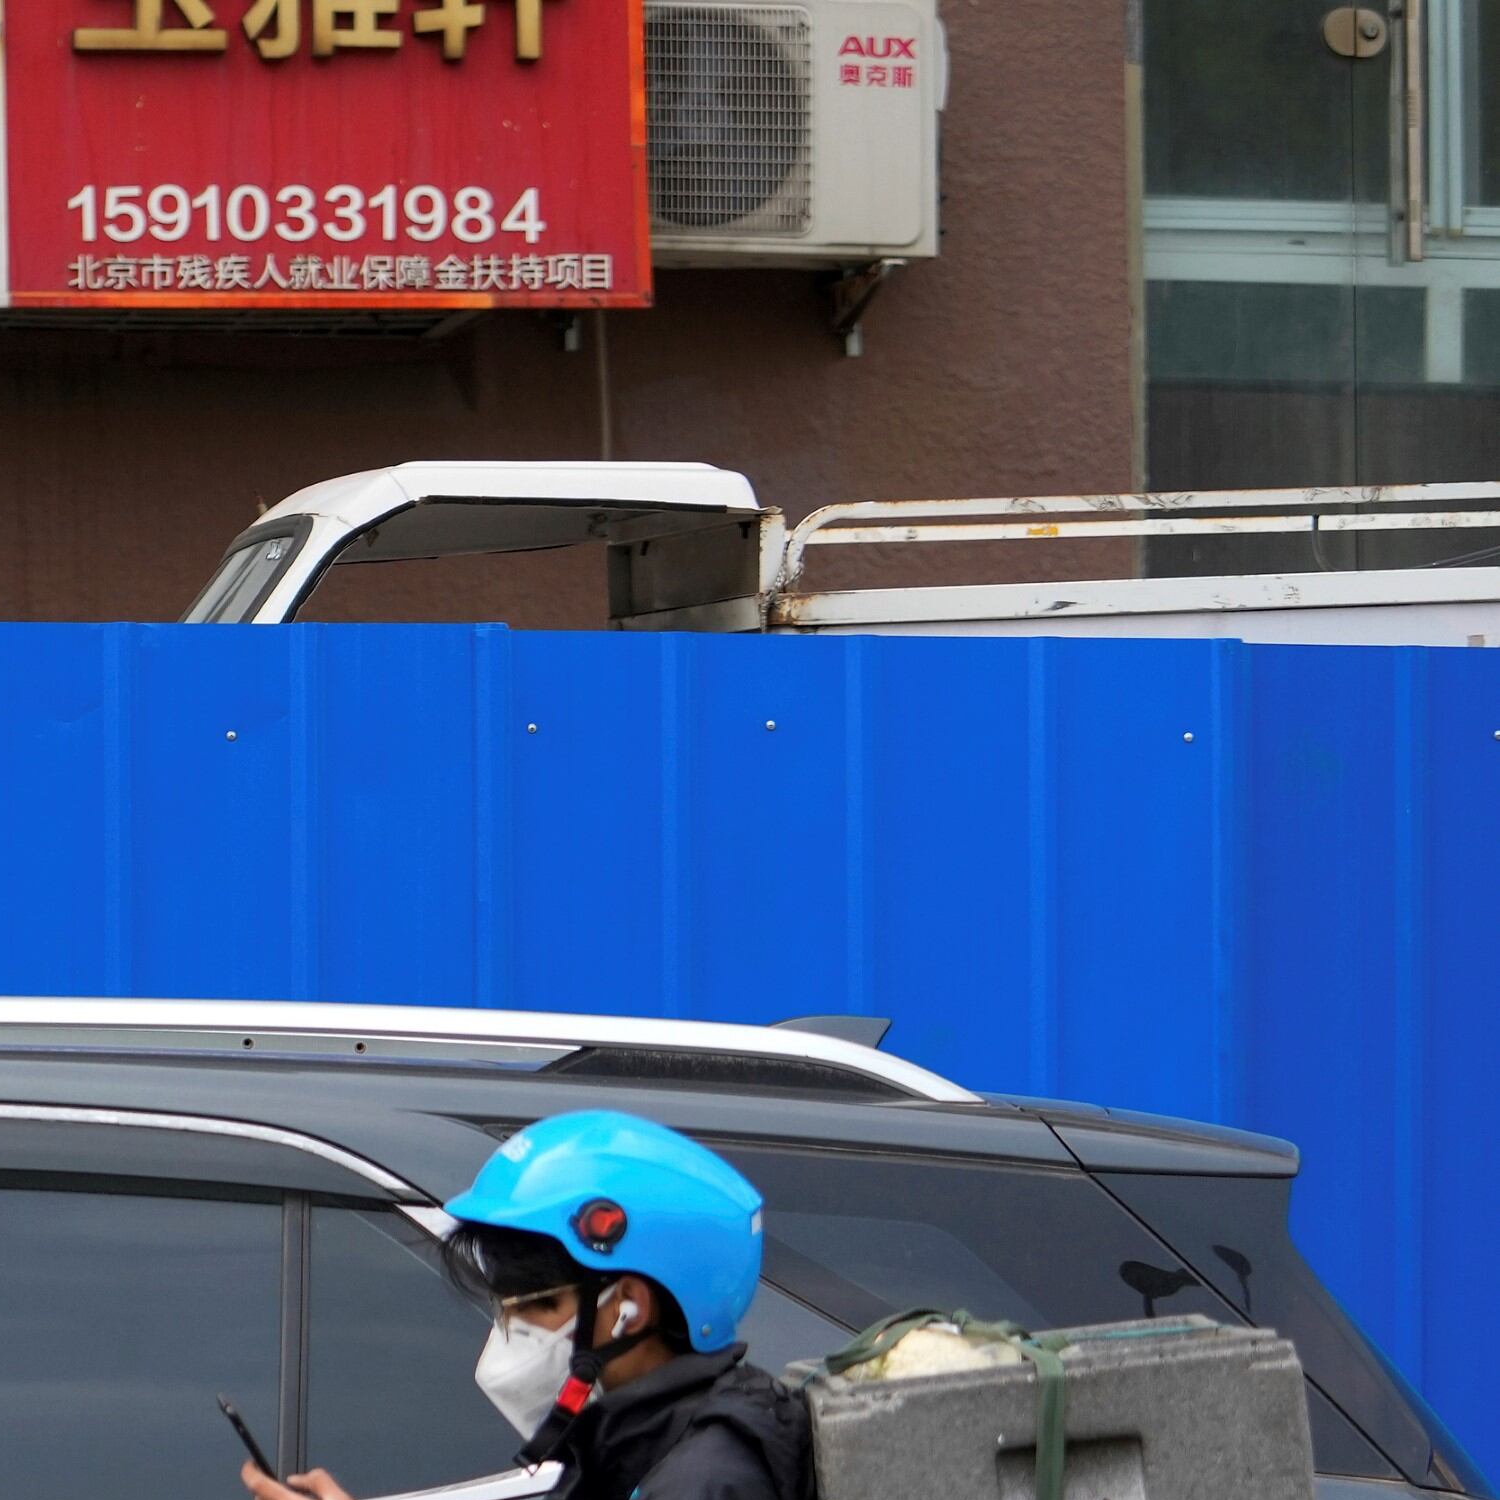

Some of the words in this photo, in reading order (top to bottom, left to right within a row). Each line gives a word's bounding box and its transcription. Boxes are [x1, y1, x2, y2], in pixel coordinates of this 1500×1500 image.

[838, 35, 916, 59] AUX
[839, 64, 914, 88] 奥克斯
[66, 183, 547, 243] 15910331984
[67, 253, 614, 291] 北京市残疾人就业保障金扶持项目
